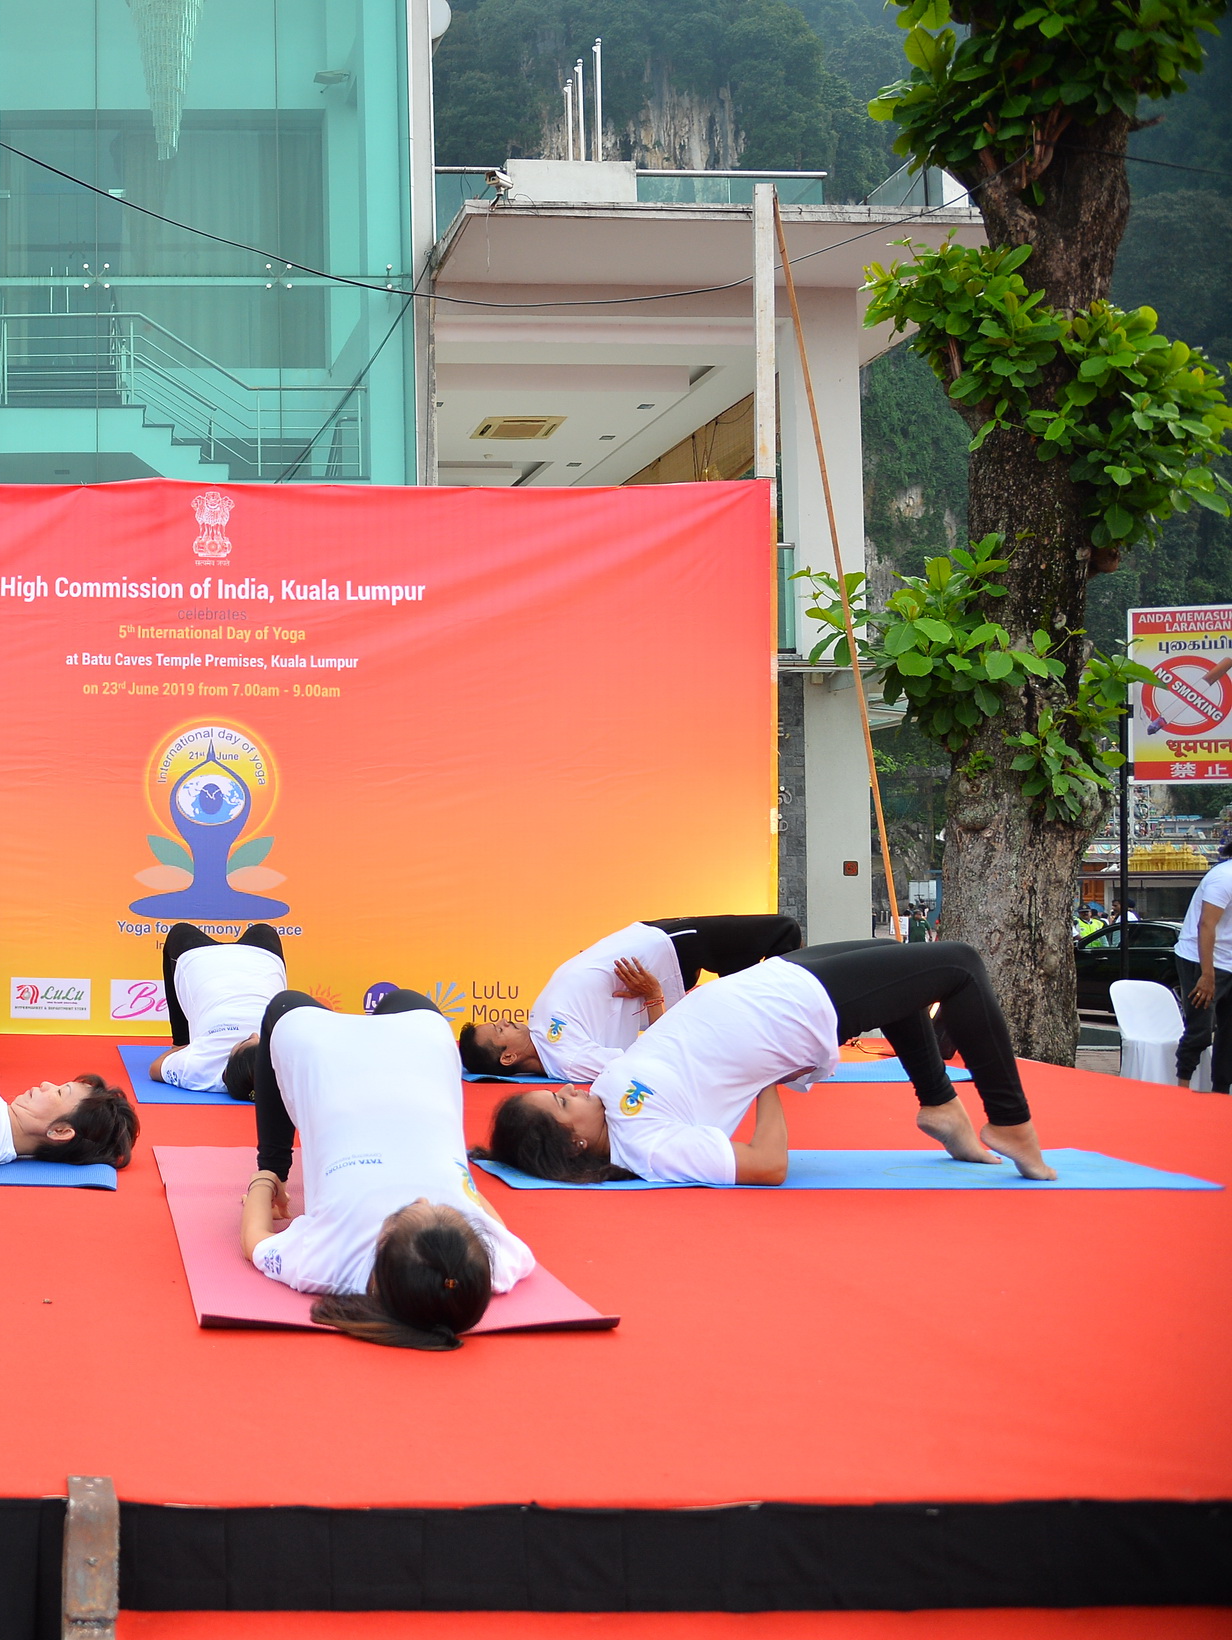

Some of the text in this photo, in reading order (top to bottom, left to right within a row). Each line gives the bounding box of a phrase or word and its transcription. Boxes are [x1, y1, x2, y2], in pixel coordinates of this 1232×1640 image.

[0, 575, 426, 606] High Commission of India, Kuala Lumpur
[177, 607, 247, 621] celebrates
[1138, 613, 1173, 623] ANDA
[119, 625, 306, 644] 5th International Day of Yoga
[1165, 620, 1231, 632] LARANGAN
[1159, 635, 1232, 654] புகைப்பி
[65, 652, 359, 671] at Batu Caves Temple Premises, Kuala Lumpur
[83, 684, 99, 695] on
[102, 681, 127, 695] 23rd
[128, 682, 159, 695] June
[162, 682, 195, 696] 2019
[198, 682, 229, 696] from
[231, 683, 280, 697] 7.00am
[293, 684, 341, 697] 9.00am
[1154, 667, 1223, 721] NO SMOKING
[157, 728, 266, 785] International day of yoga
[188, 751, 239, 761] 21st June
[117, 921, 151, 935] Yoga
[40, 986, 85, 1001] LuLu
[112, 981, 168, 1019] Be
[472, 981, 519, 1000] LuLu
